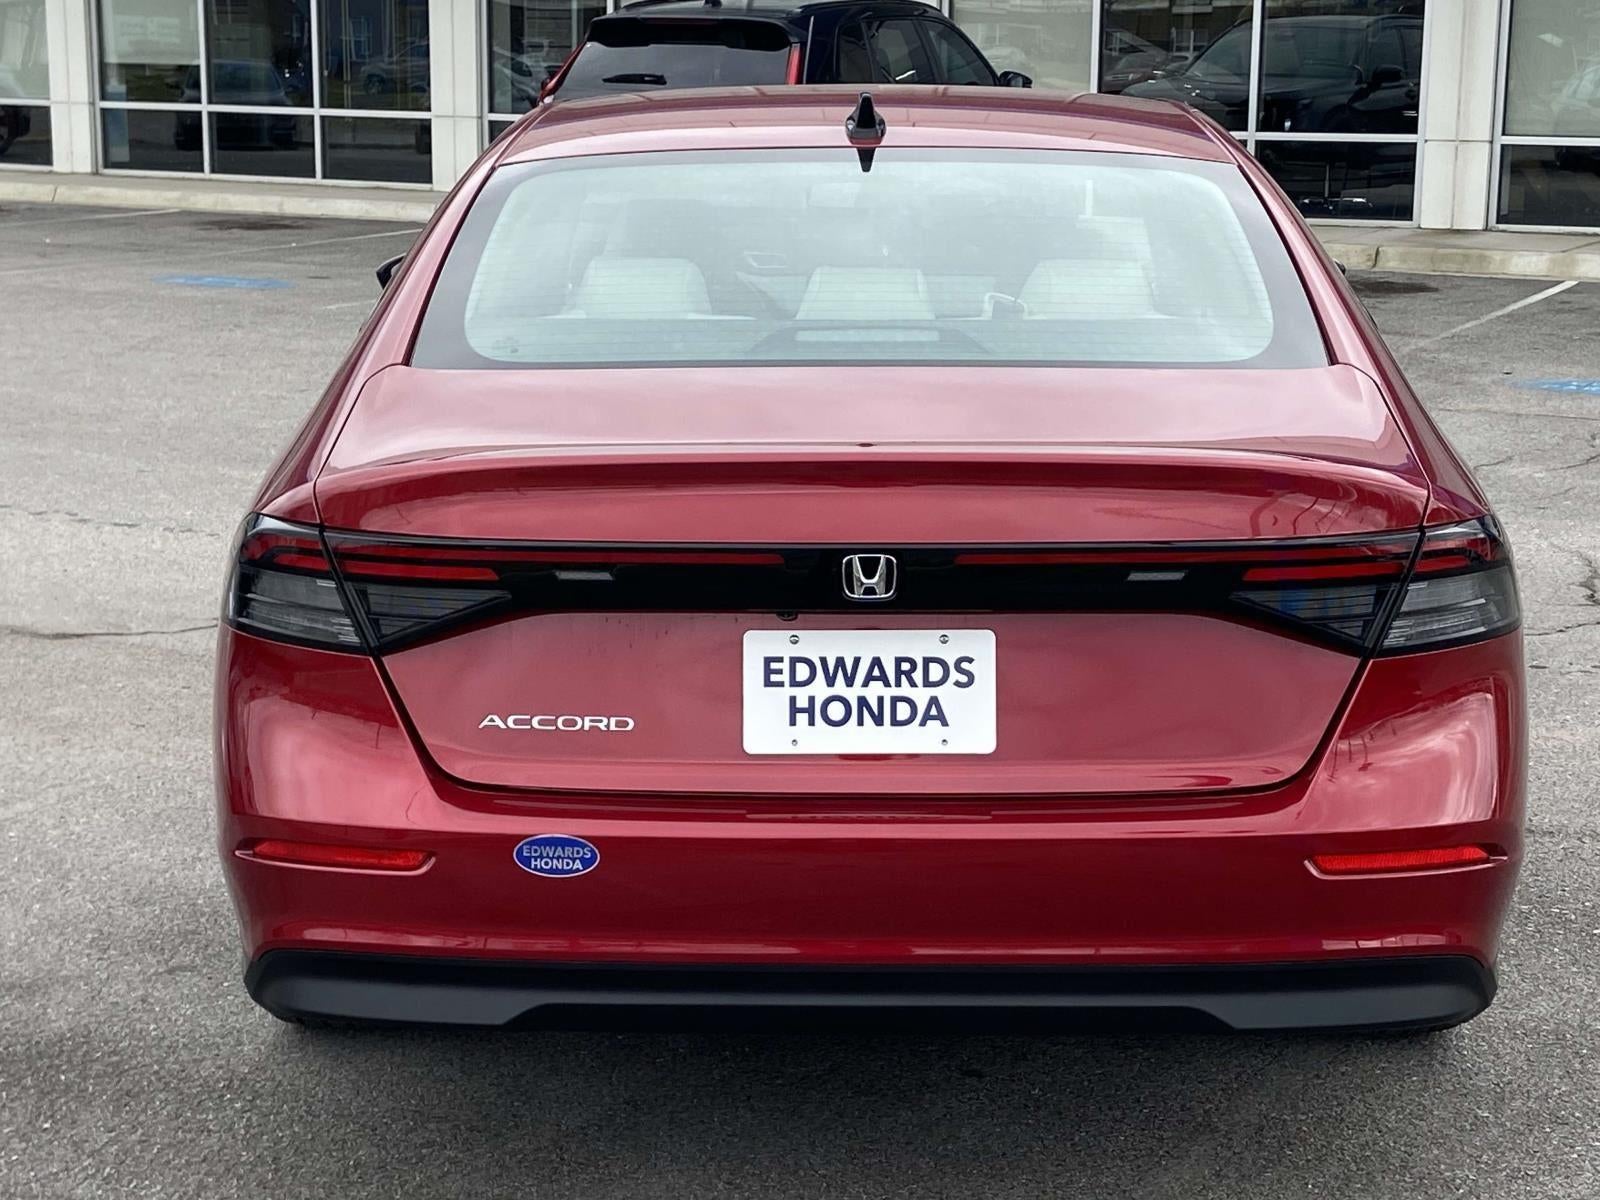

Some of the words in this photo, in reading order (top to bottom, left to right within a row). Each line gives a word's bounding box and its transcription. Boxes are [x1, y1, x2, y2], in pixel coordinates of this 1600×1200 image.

[763, 655, 976, 689] EDWARDS
[789, 694, 950, 728] HONDA
[478, 714, 635, 732] ACCORD
[522, 845, 592, 859] EDWARDS
[530, 858, 584, 870] HONDA
